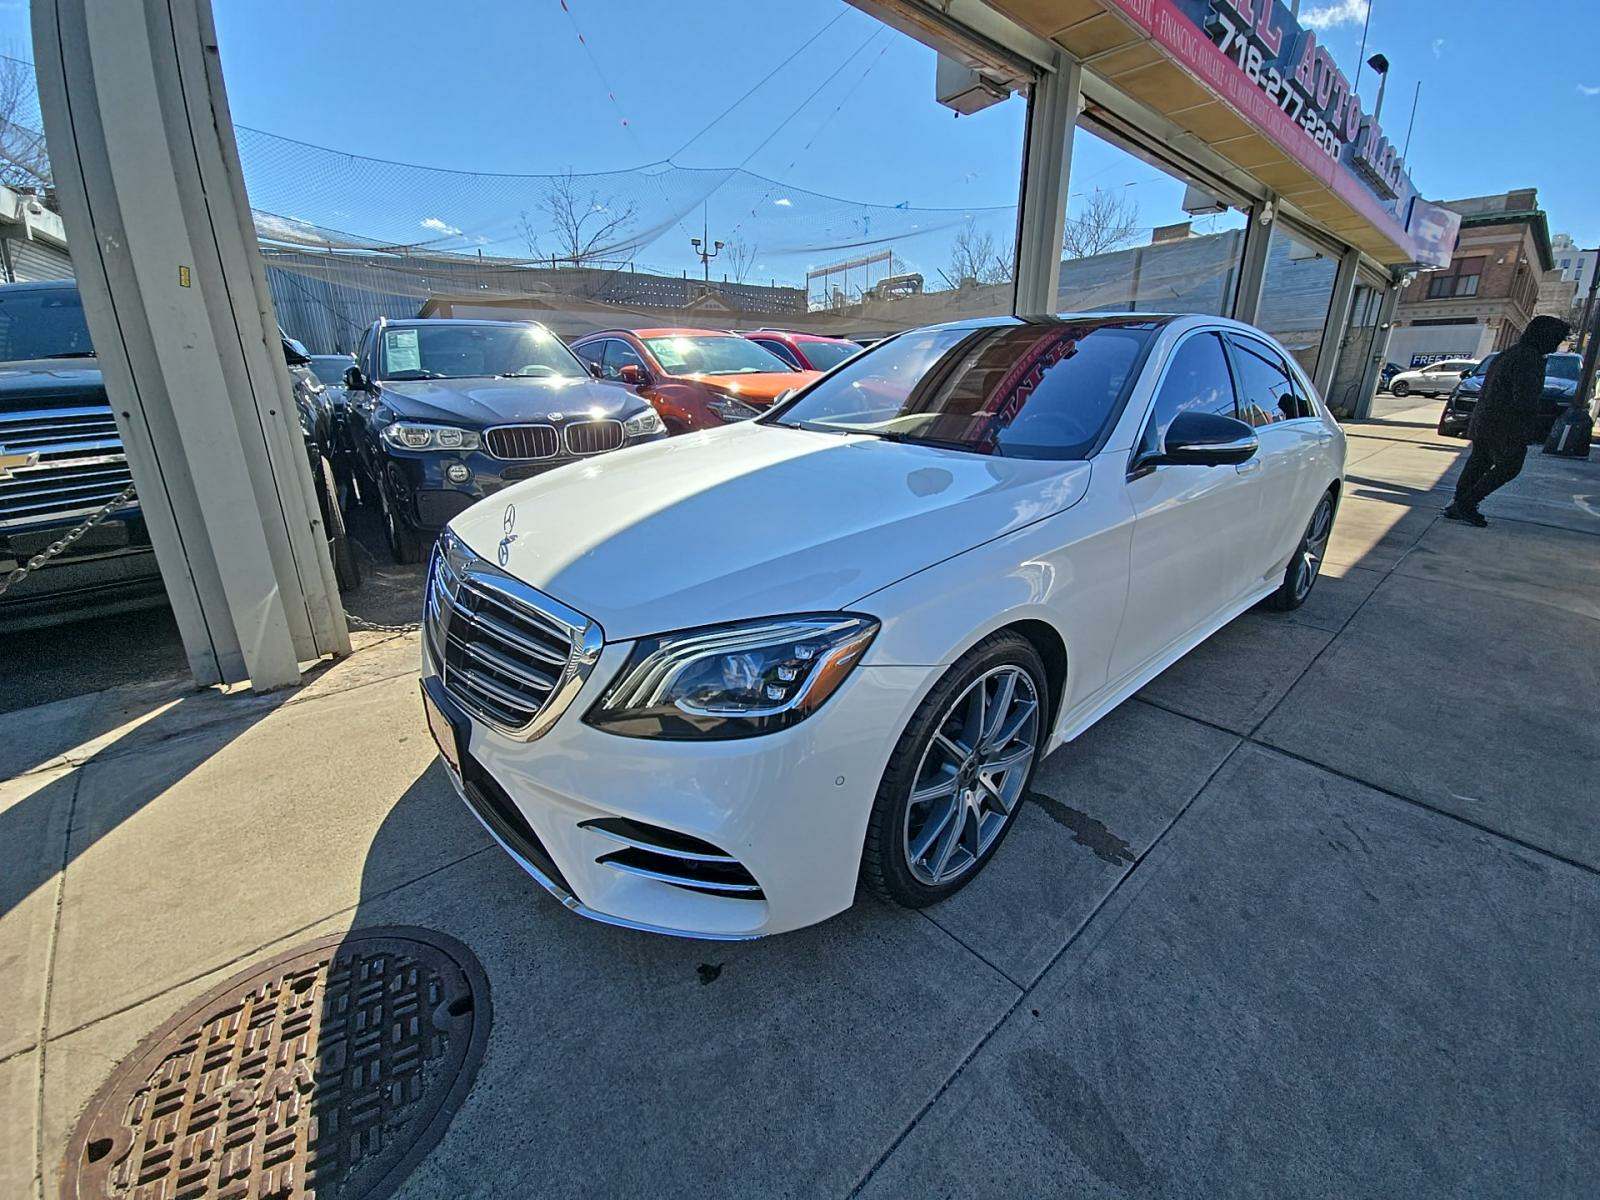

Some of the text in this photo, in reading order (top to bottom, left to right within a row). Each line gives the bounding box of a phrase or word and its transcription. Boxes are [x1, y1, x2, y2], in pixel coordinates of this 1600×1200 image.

[1159, 9, 1198, 63] FINANCING
[1219, 12, 1341, 163] 718-277-2200
[1294, 29, 1361, 142] AUTO
[1413, 355, 1442, 364] FREE
